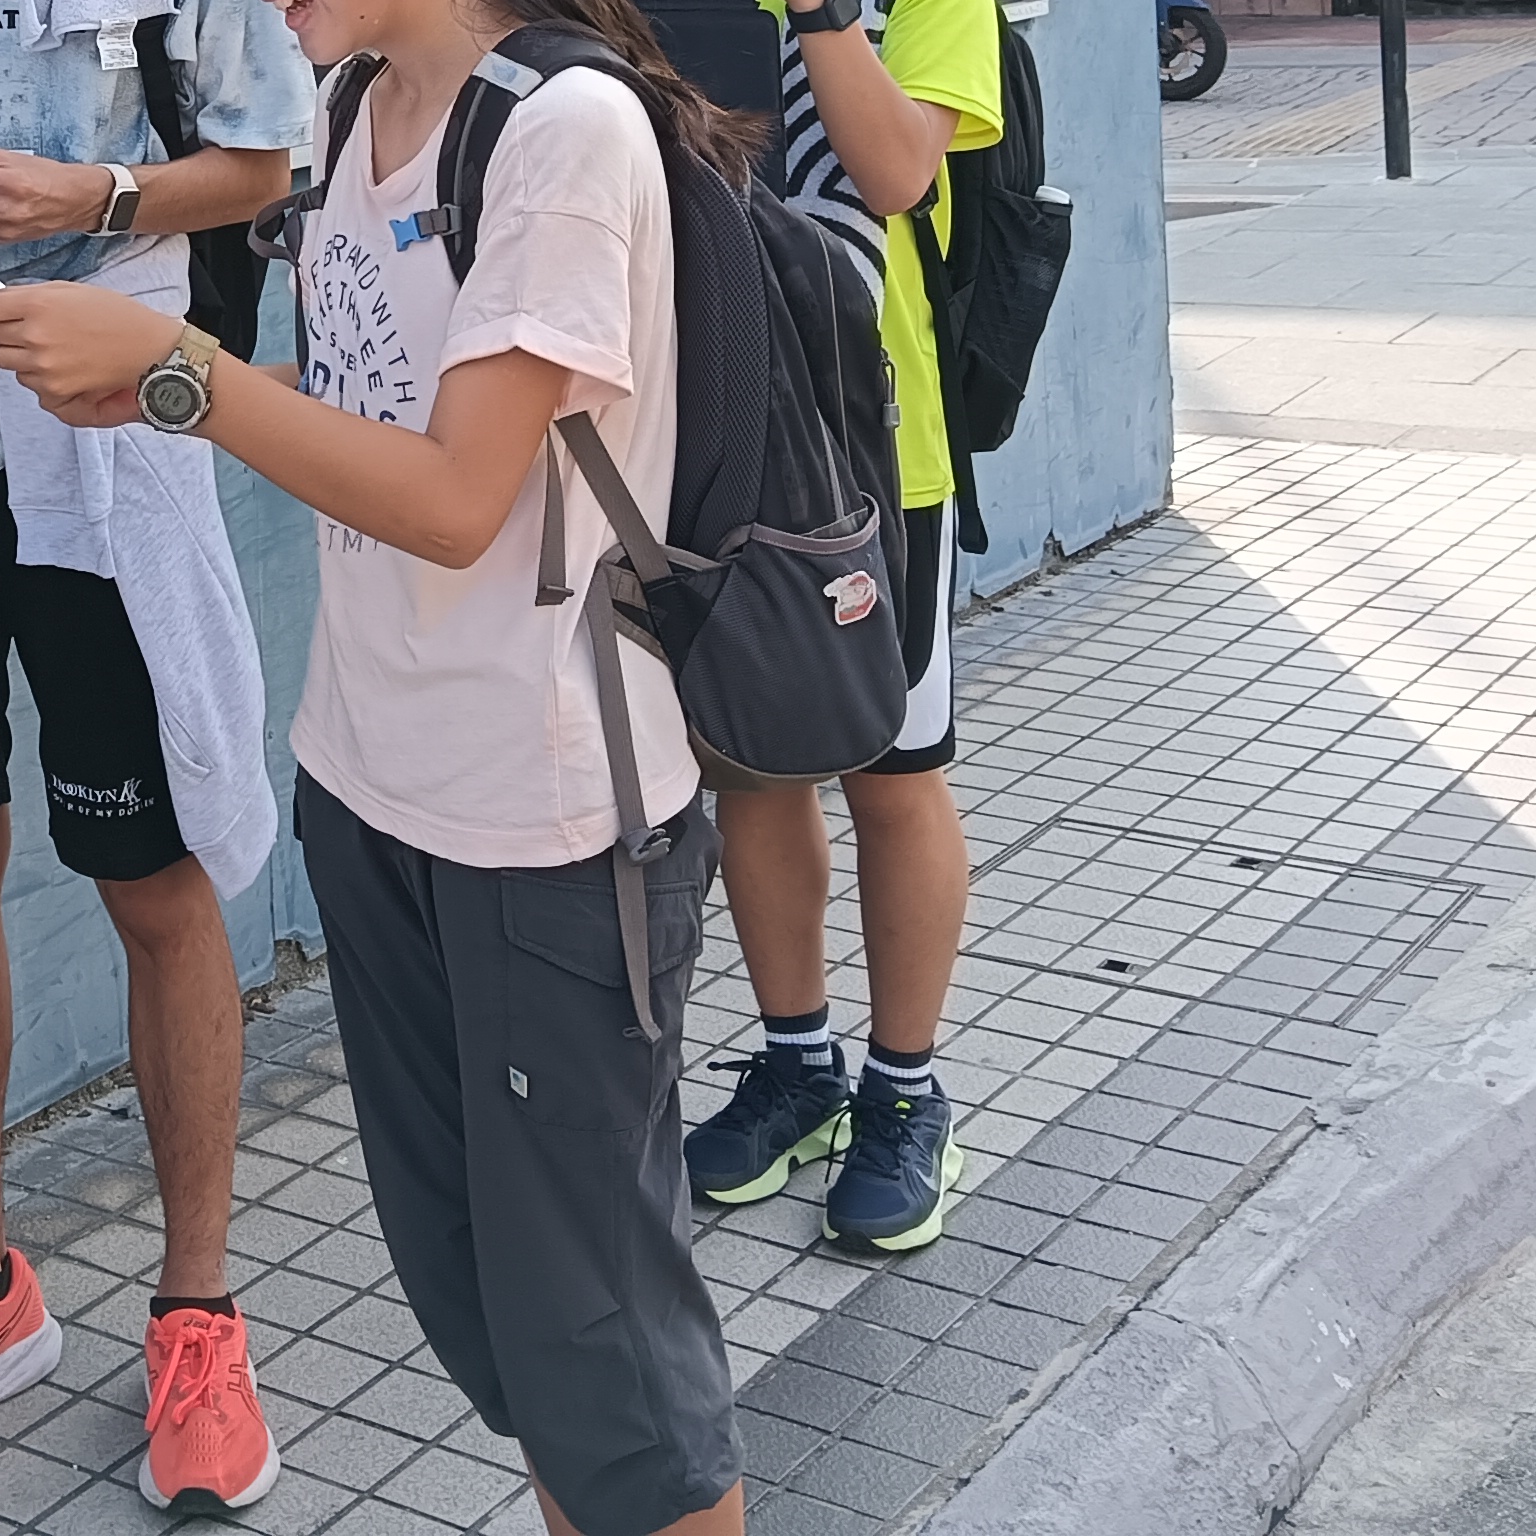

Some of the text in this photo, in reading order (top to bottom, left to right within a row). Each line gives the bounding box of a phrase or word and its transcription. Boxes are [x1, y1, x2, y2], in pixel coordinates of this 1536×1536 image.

[323, 233, 417, 403] BRAND WITH
[78, 805, 91, 816] OF
